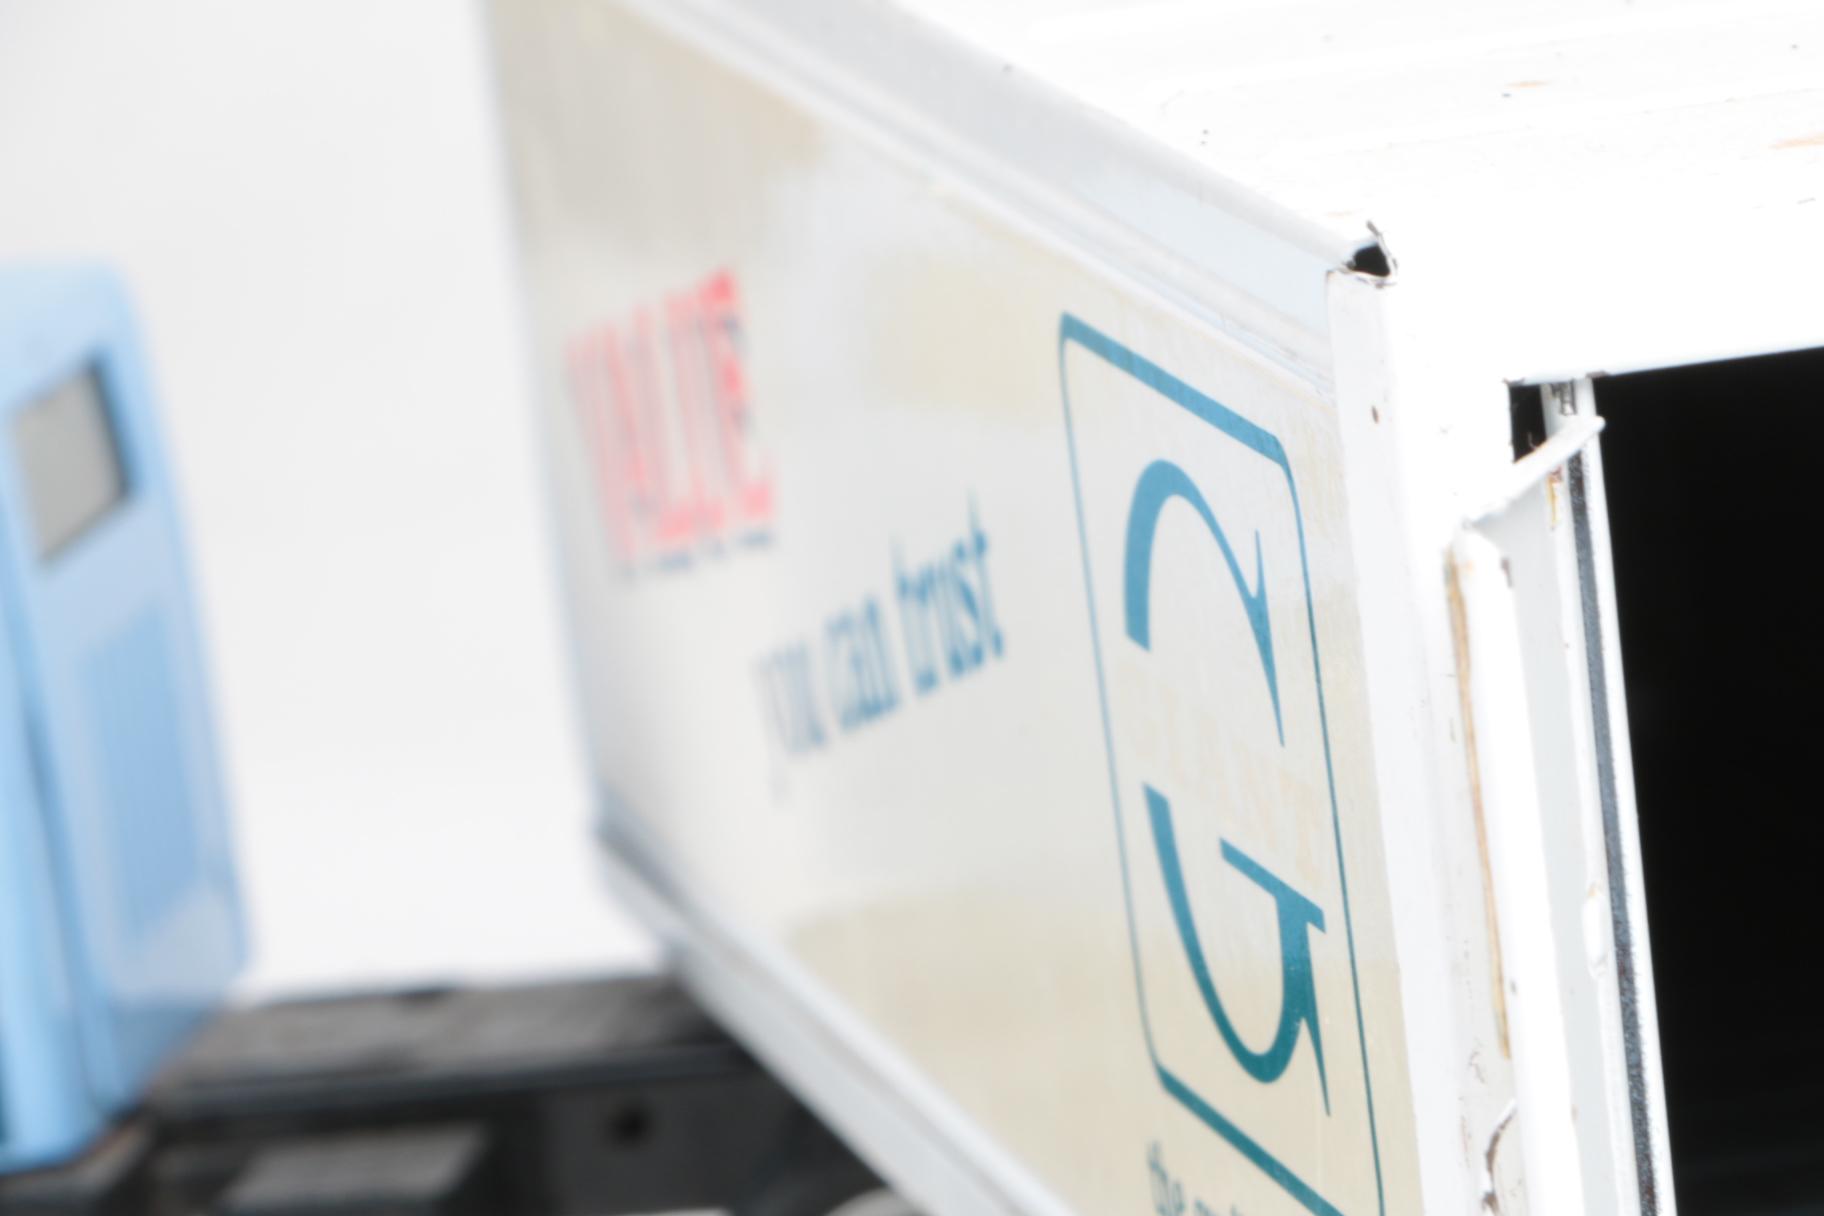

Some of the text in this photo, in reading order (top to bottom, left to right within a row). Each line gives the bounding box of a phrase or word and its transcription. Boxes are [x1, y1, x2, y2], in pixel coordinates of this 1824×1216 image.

[565, 263, 774, 578] VALUE
[823, 592, 902, 732] can
[893, 488, 1008, 696] trust
[1123, 458, 1331, 1117] G
